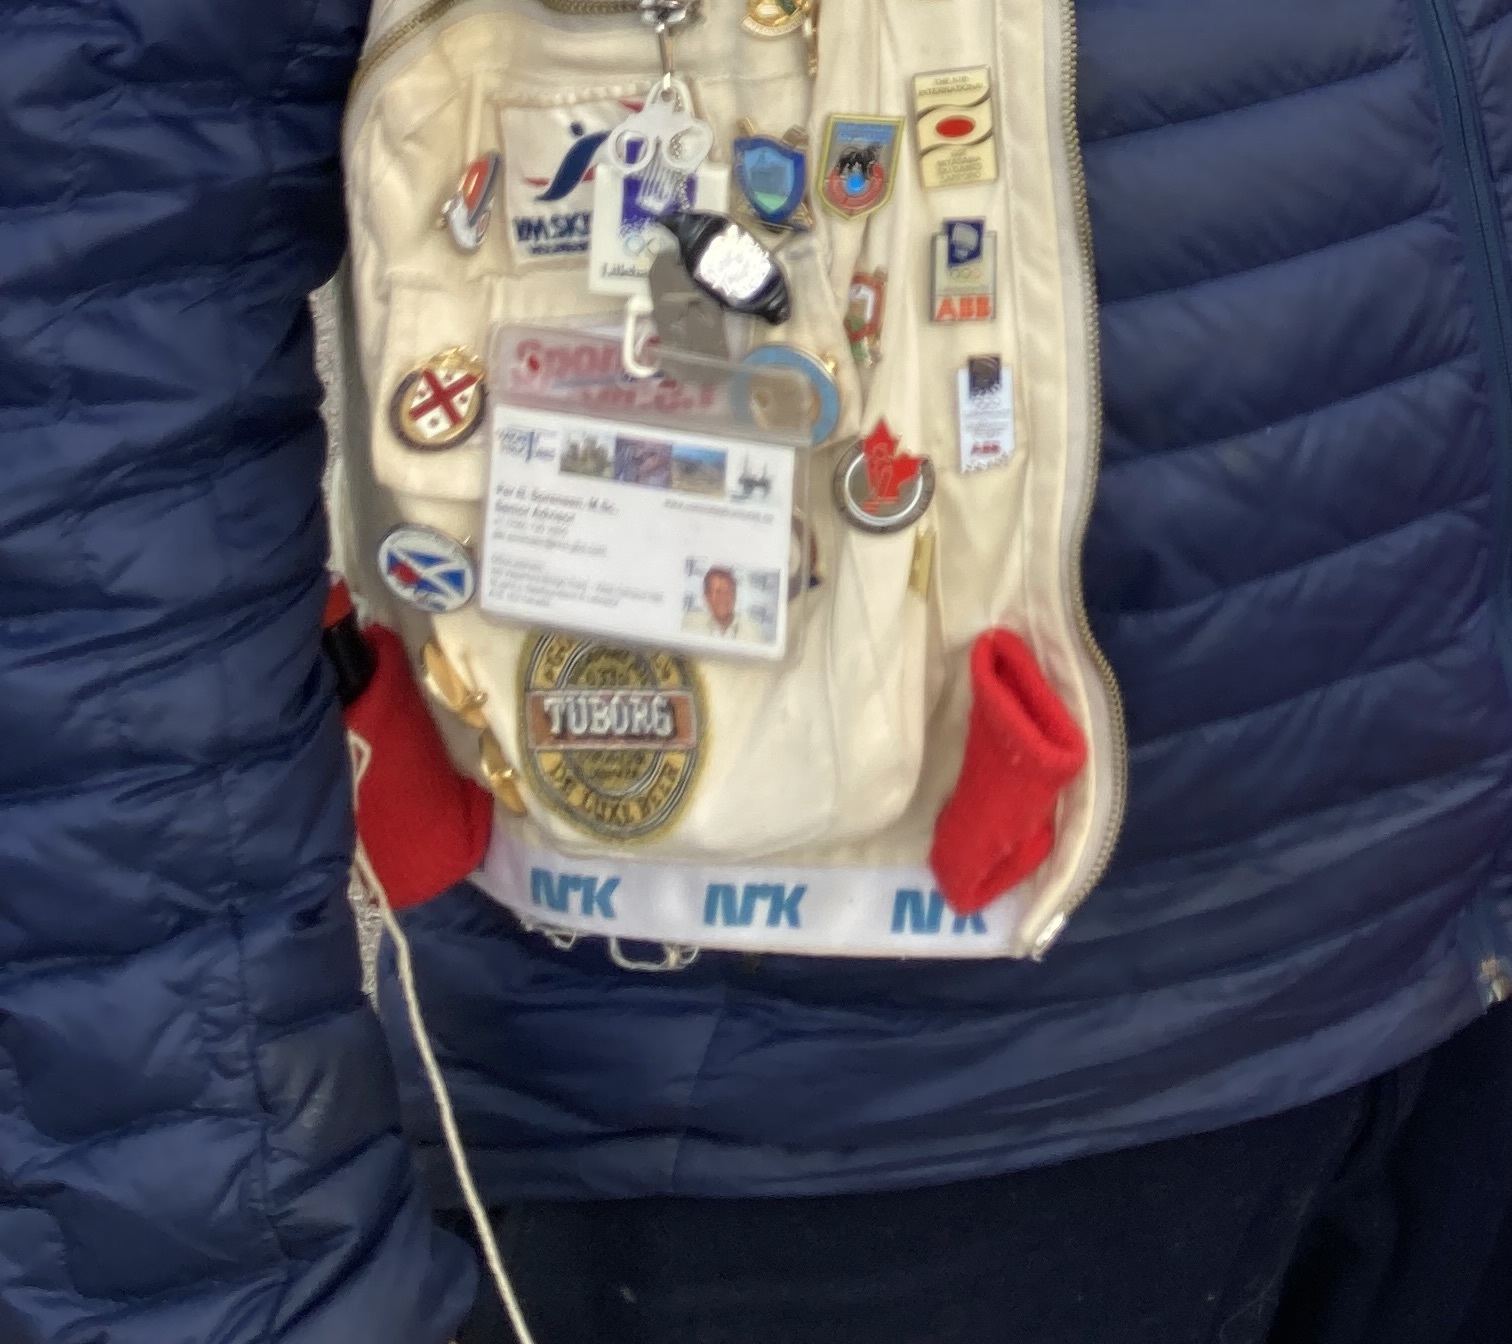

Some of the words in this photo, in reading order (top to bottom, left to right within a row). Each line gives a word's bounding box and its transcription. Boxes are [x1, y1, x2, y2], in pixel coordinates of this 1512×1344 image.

[935, 295, 993, 322] ABB
[543, 692, 676, 738] TUBORG
[530, 867, 621, 921] NRK
[703, 882, 806, 928] NRK
